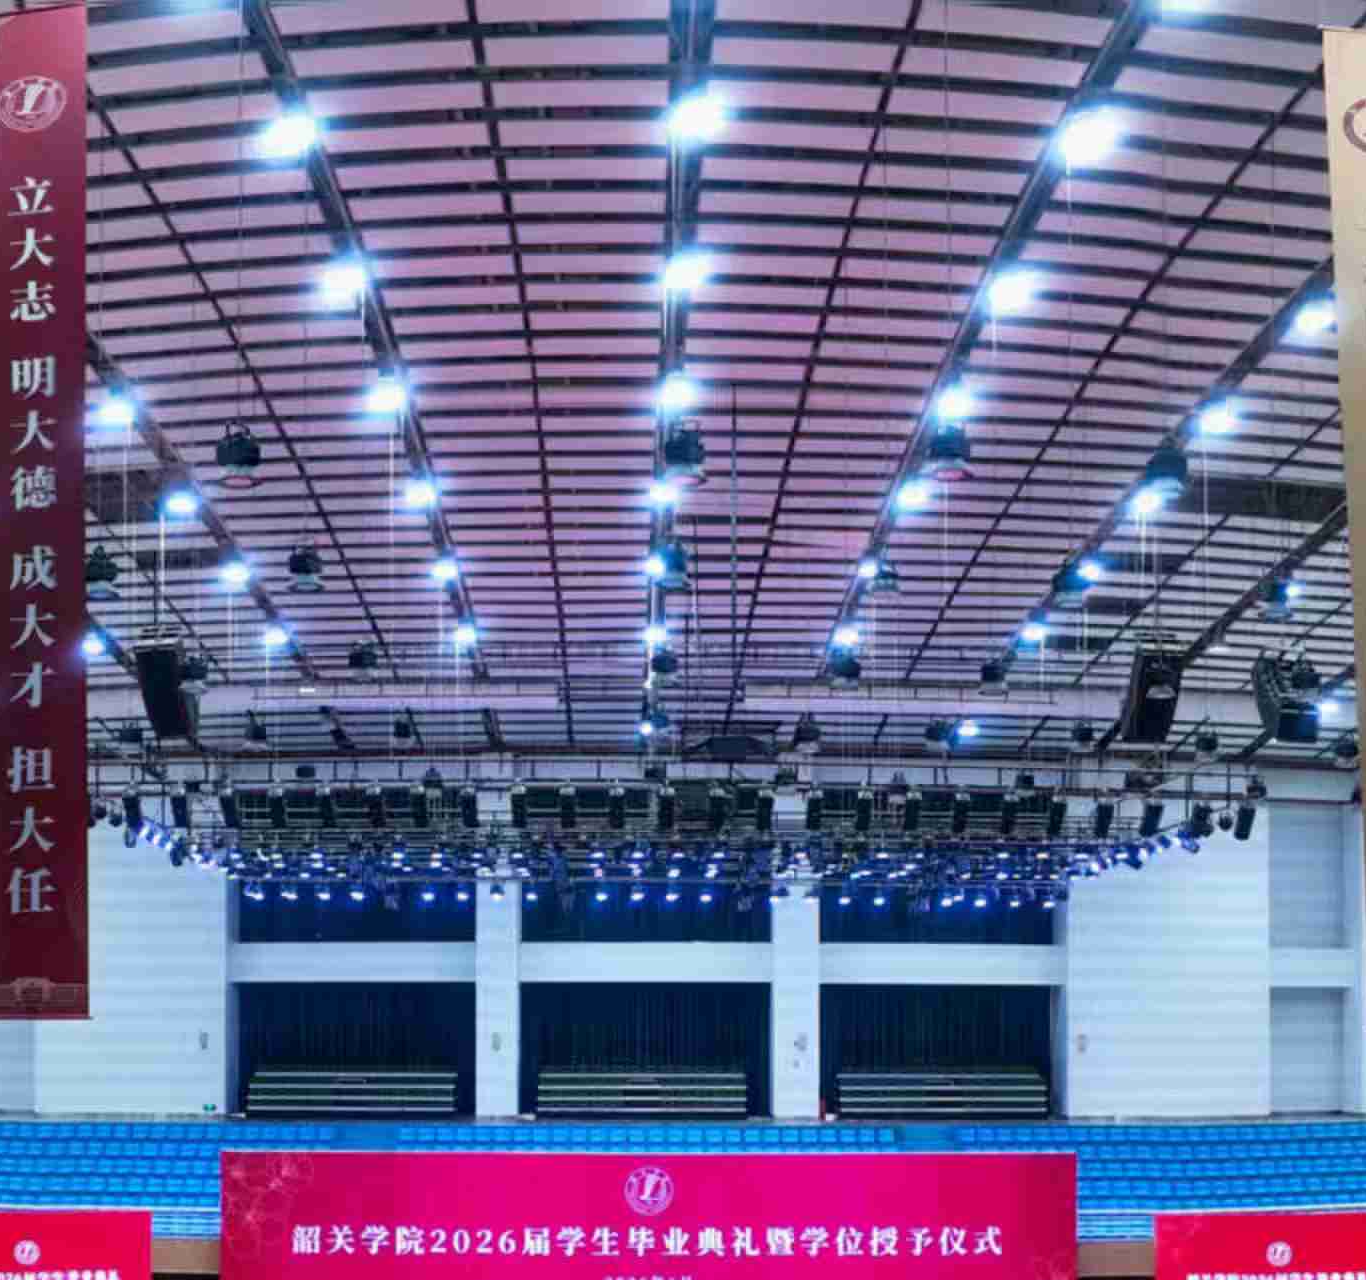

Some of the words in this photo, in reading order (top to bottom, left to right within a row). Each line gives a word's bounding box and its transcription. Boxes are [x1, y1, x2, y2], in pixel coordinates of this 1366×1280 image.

[7, 176, 57, 321] 立大志
[8, 355, 58, 511] 明大德
[8, 545, 59, 708] 成大才
[5, 745, 58, 915] 担大任
[291, 1223, 1004, 1257] 韶关学院2026届学生毕业典礼暨学位授予仪式
